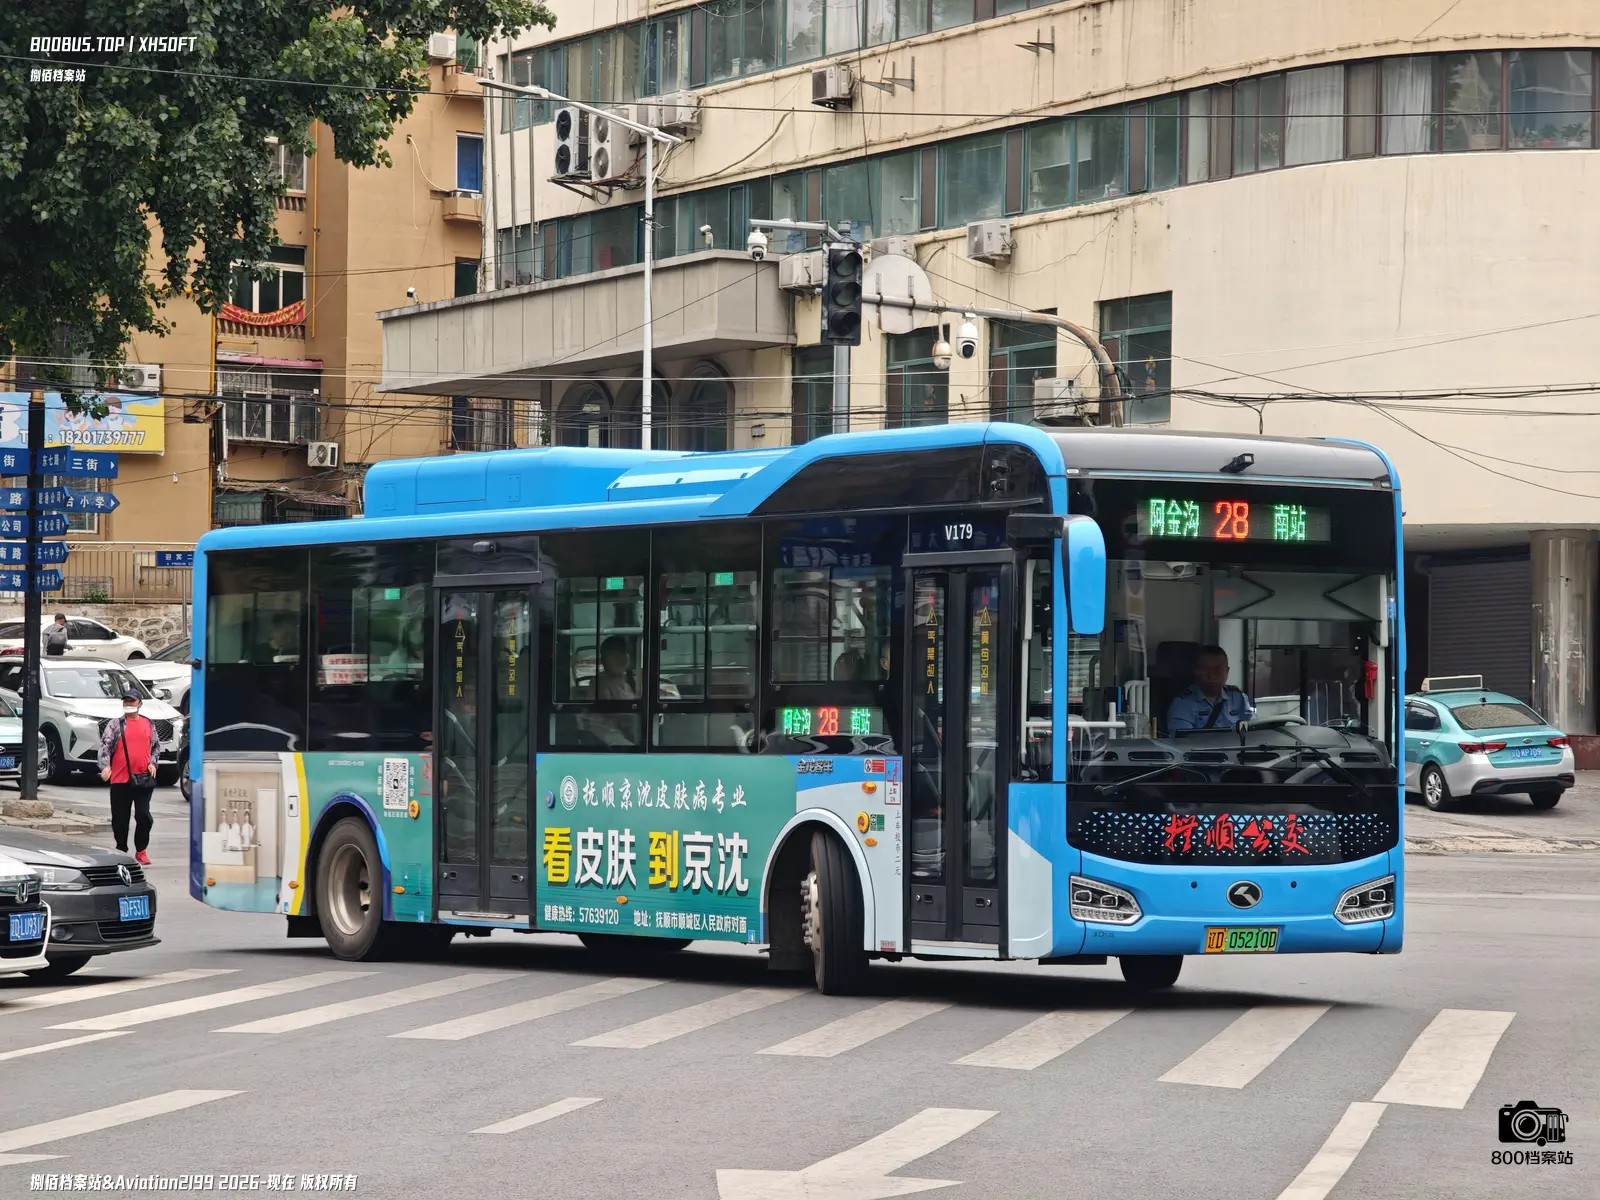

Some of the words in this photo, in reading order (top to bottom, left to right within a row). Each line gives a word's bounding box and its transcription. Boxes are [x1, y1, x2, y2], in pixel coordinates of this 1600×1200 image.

[59, 430, 146, 445] 18201739777
[3, 454, 15, 468] 街
[42, 454, 60, 468] 东七路
[1, 519, 22, 533] 公司
[1149, 499, 1200, 537] 阿金沟
[1215, 501, 1249, 540] 28
[1274, 504, 1307, 541] 南站
[945, 523, 973, 541] V179
[818, 706, 839, 735] 28
[583, 777, 748, 815] 抚顺京沈皮肤病专业
[543, 826, 637, 889] 看皮肤
[648, 829, 749, 893] 到京沈
[579, 907, 620, 925] 57639120
[655, 910, 748, 934] 抚顺市顺城区人民政府对面
